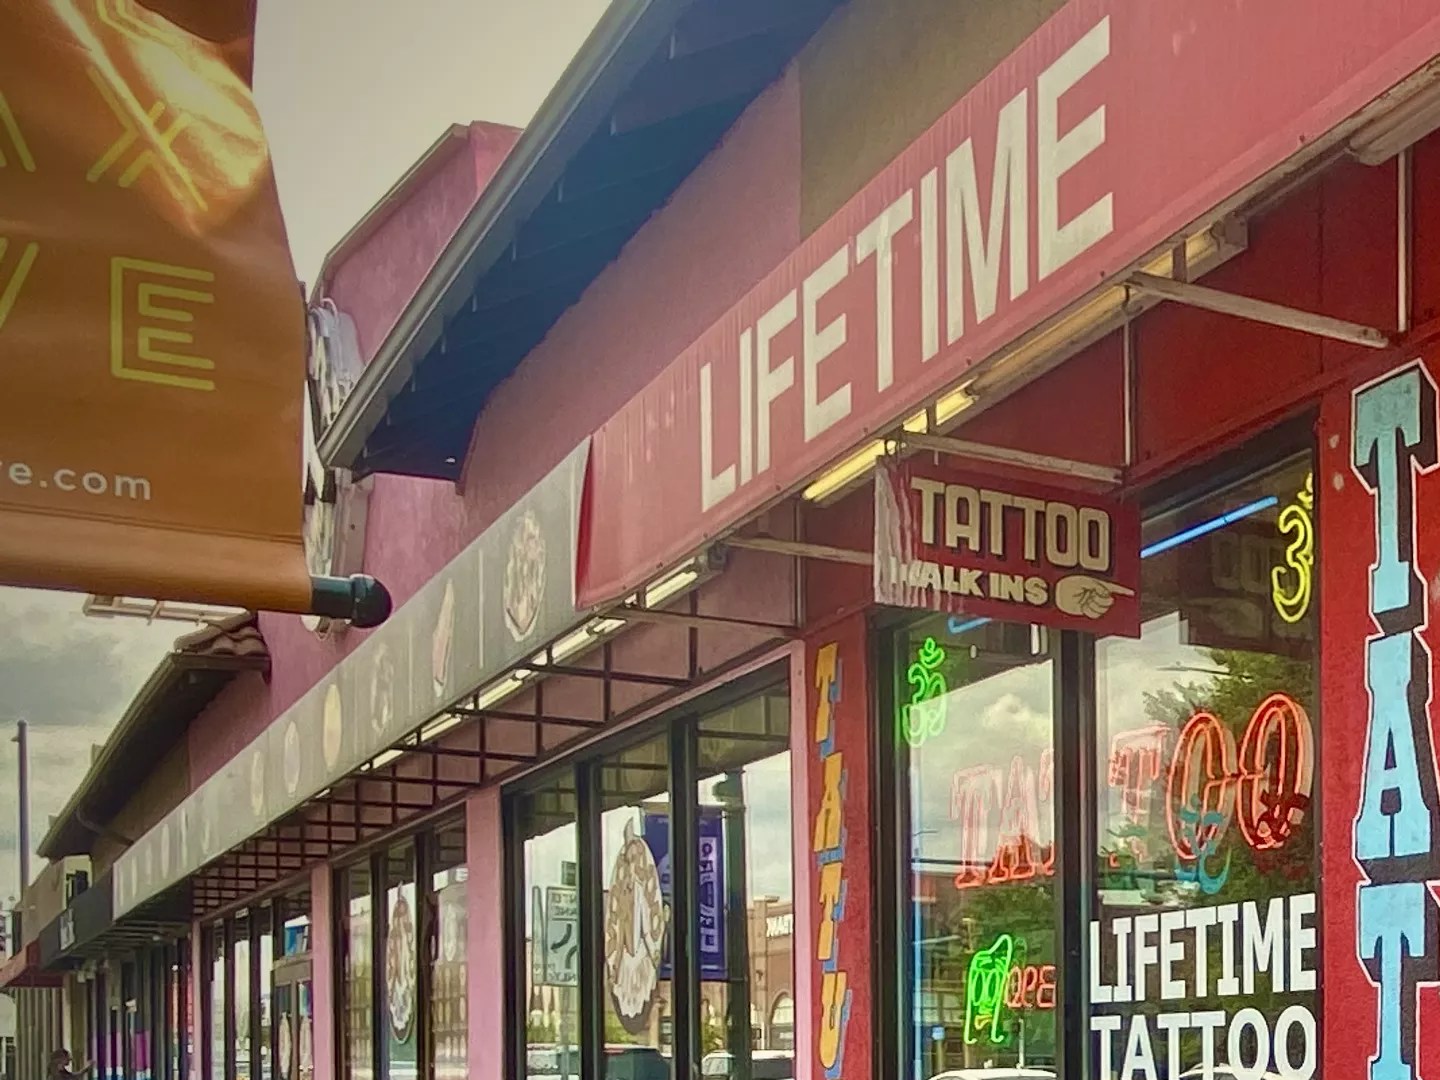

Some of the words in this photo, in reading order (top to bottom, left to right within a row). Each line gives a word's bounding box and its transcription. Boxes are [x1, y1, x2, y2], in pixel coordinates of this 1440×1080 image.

[700, 15, 1114, 513] LIFETIME
[0, 460, 151, 501] e.com
[910, 476, 1110, 572] TATTOO
[889, 556, 985, 599] WALK
[988, 572, 1048, 606] INS
[1089, 893, 1317, 1004] LIFETIME
